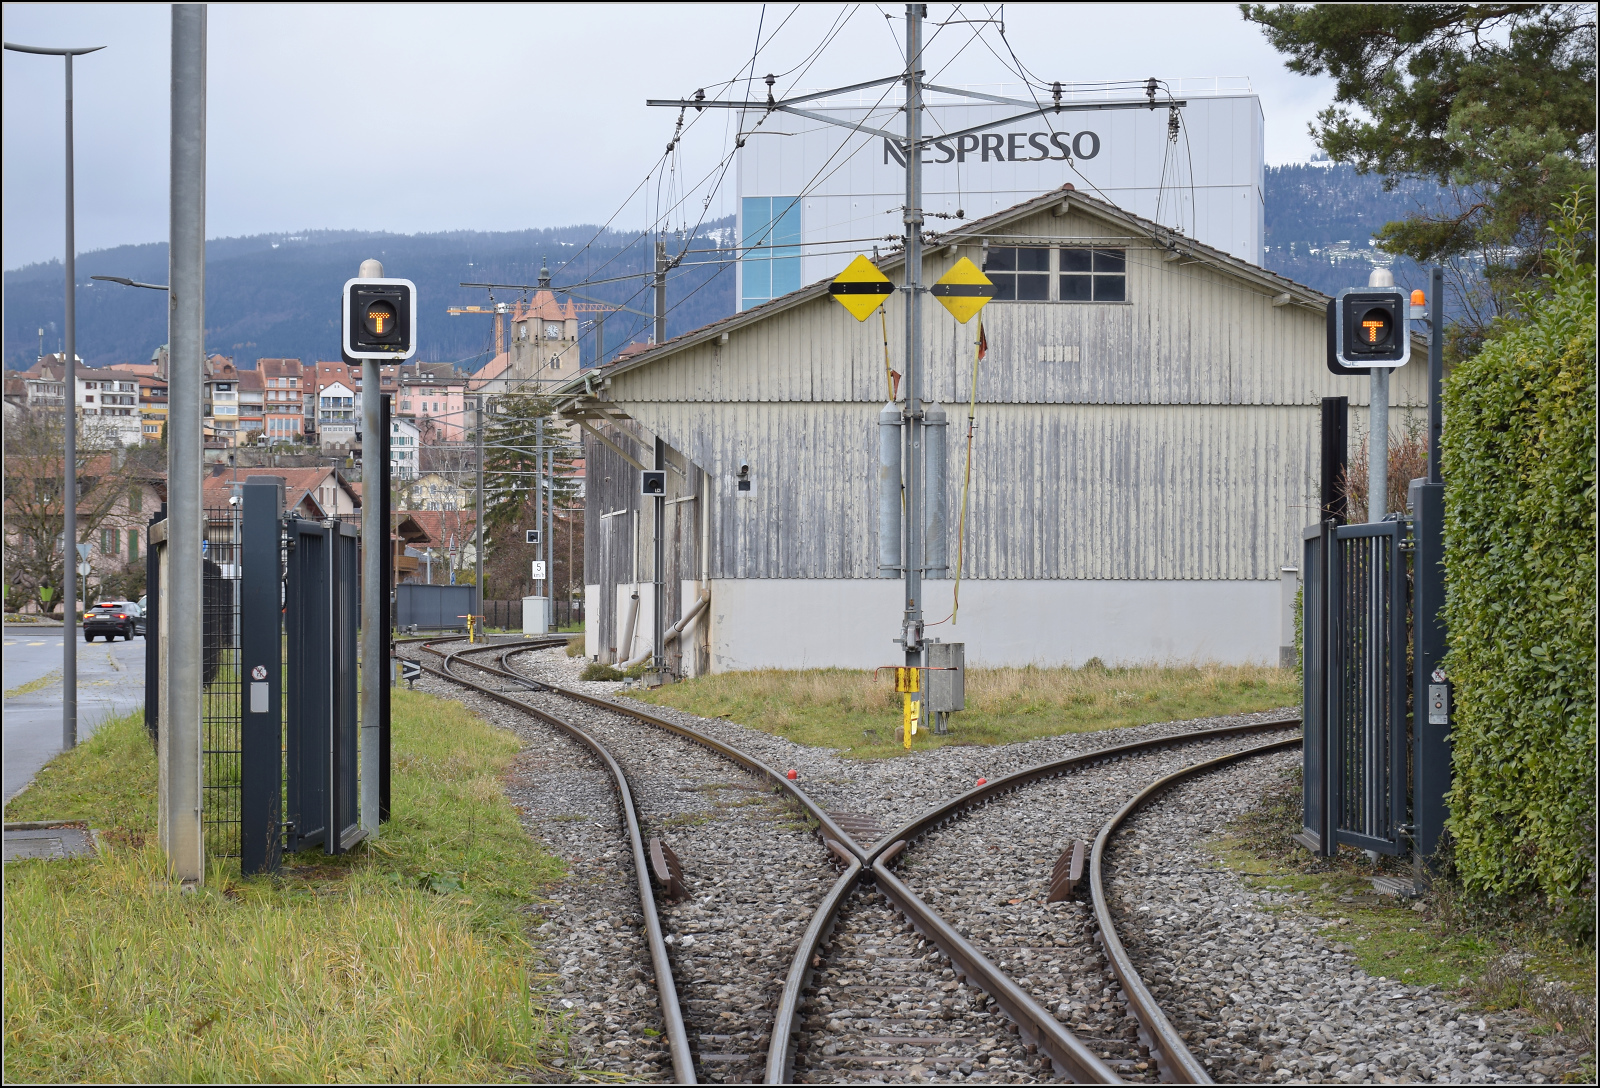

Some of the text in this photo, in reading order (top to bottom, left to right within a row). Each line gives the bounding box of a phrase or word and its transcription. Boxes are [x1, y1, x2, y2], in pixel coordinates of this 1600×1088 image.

[369, 312, 390, 333] T
[1362, 320, 1384, 342] T
[536, 563, 541, 571] 5
